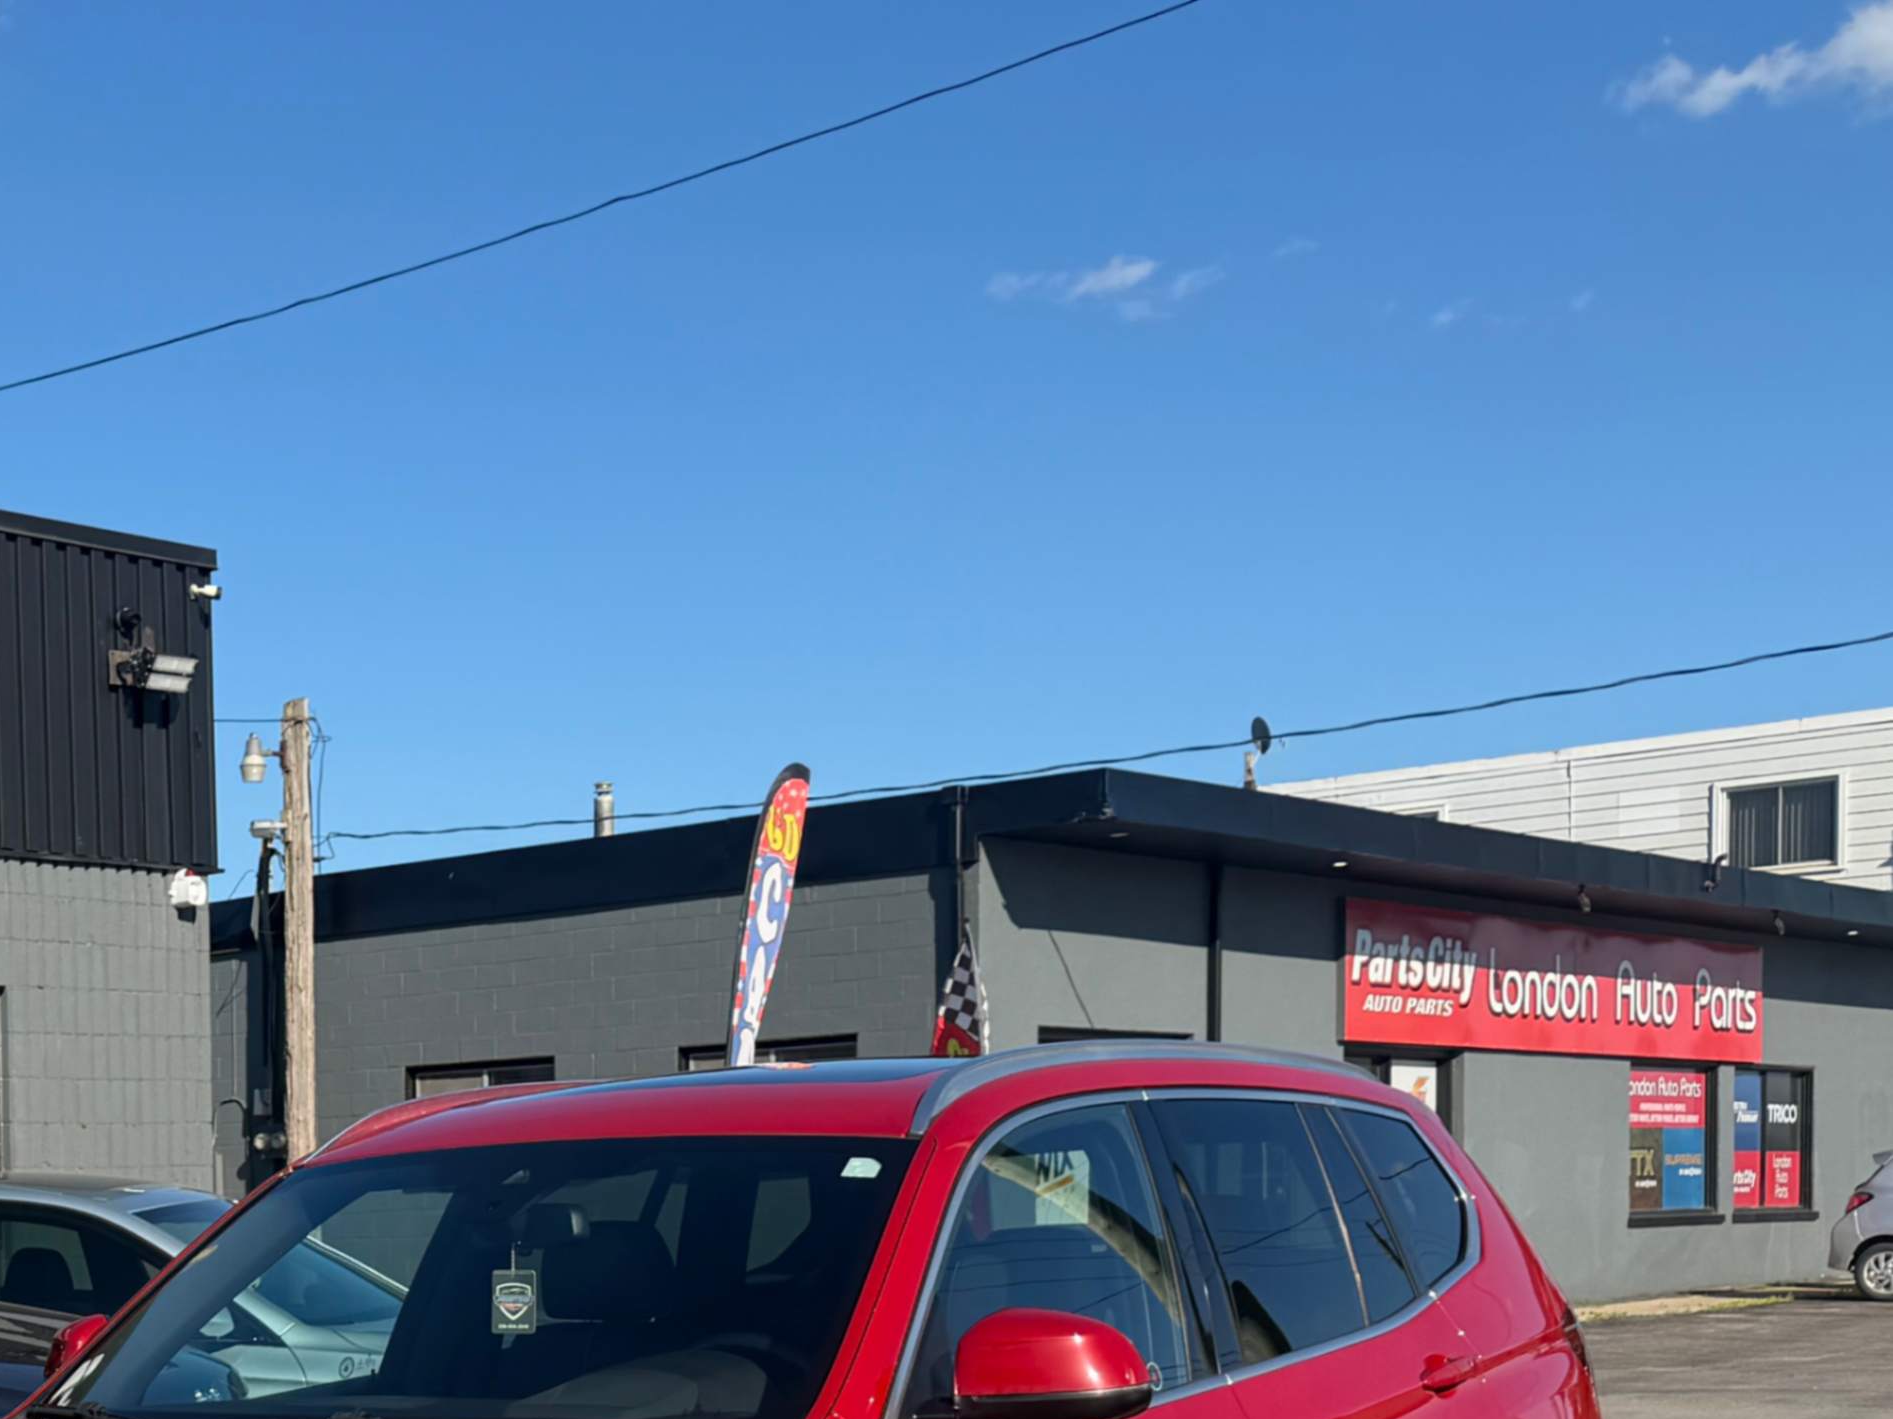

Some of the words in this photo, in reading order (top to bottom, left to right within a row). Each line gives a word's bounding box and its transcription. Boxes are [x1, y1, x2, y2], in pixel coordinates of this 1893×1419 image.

[1351, 928, 1478, 1006] PartsCity
[1489, 947, 1598, 1020] London
[1615, 960, 1678, 1027] Auto
[1694, 968, 1756, 1032] Parts
[1362, 994, 1403, 1013] AUTO
[1405, 996, 1455, 1017] PARTS
[1628, 1076, 1657, 1097] ondon
[1657, 1076, 1679, 1097] Auto
[1680, 1077, 1702, 1098] Parts
[1767, 1103, 1798, 1124] TRICO
